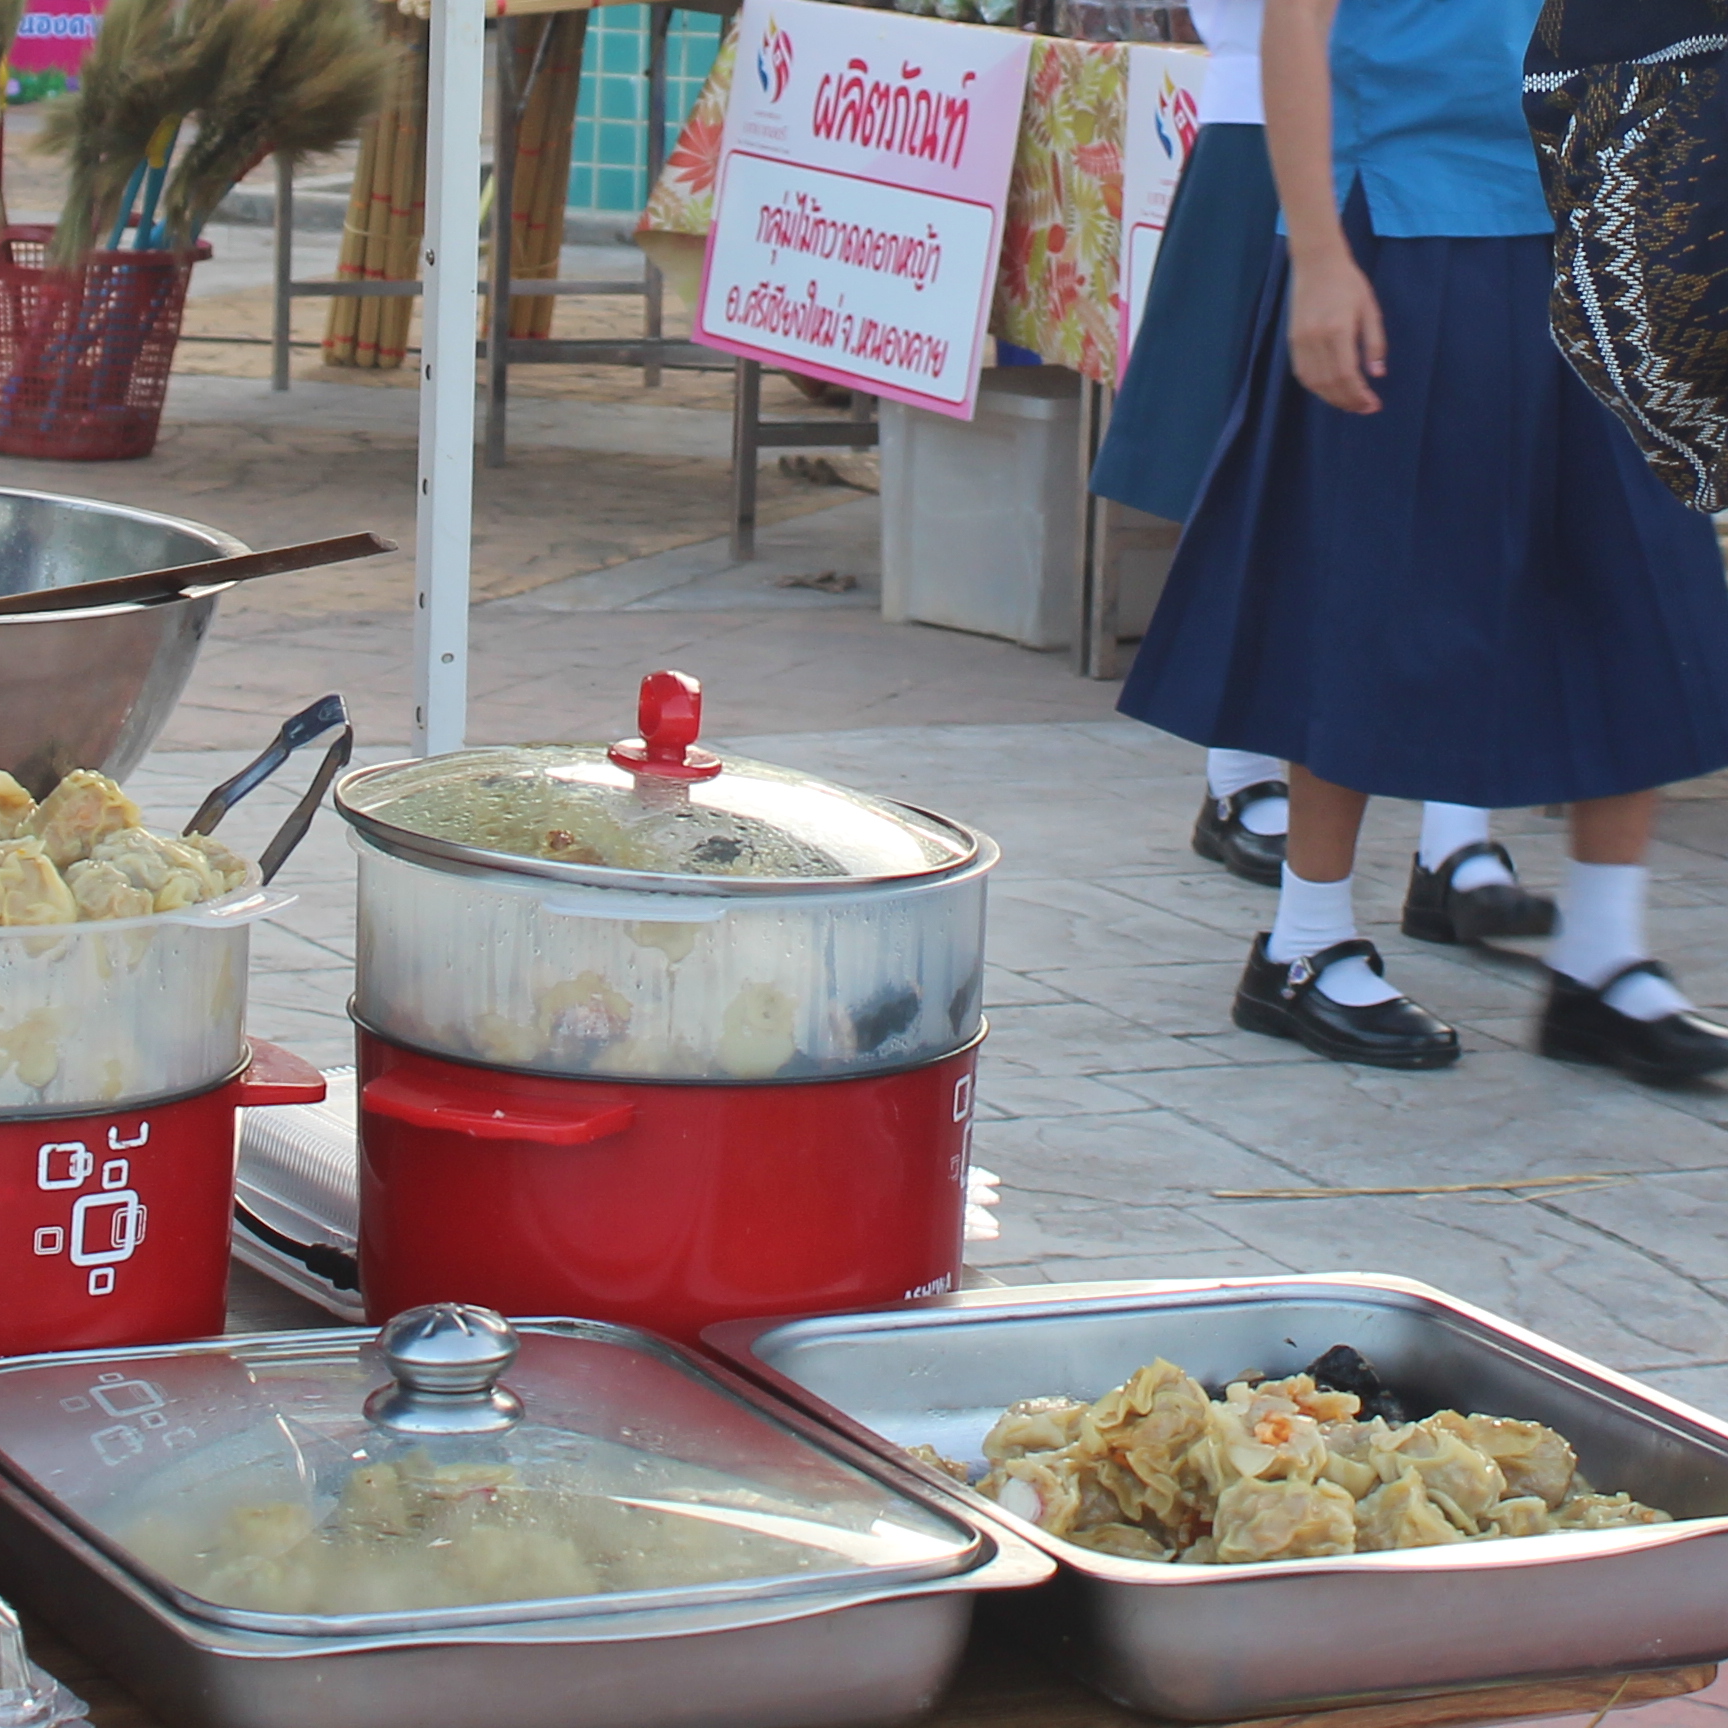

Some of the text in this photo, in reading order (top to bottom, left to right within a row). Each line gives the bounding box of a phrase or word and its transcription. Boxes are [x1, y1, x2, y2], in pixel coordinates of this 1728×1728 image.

[812, 57, 977, 171] ผลิตภัณฑ์
[755, 189, 942, 293] กลุ่มไม้กวาดดอกหญ้า
